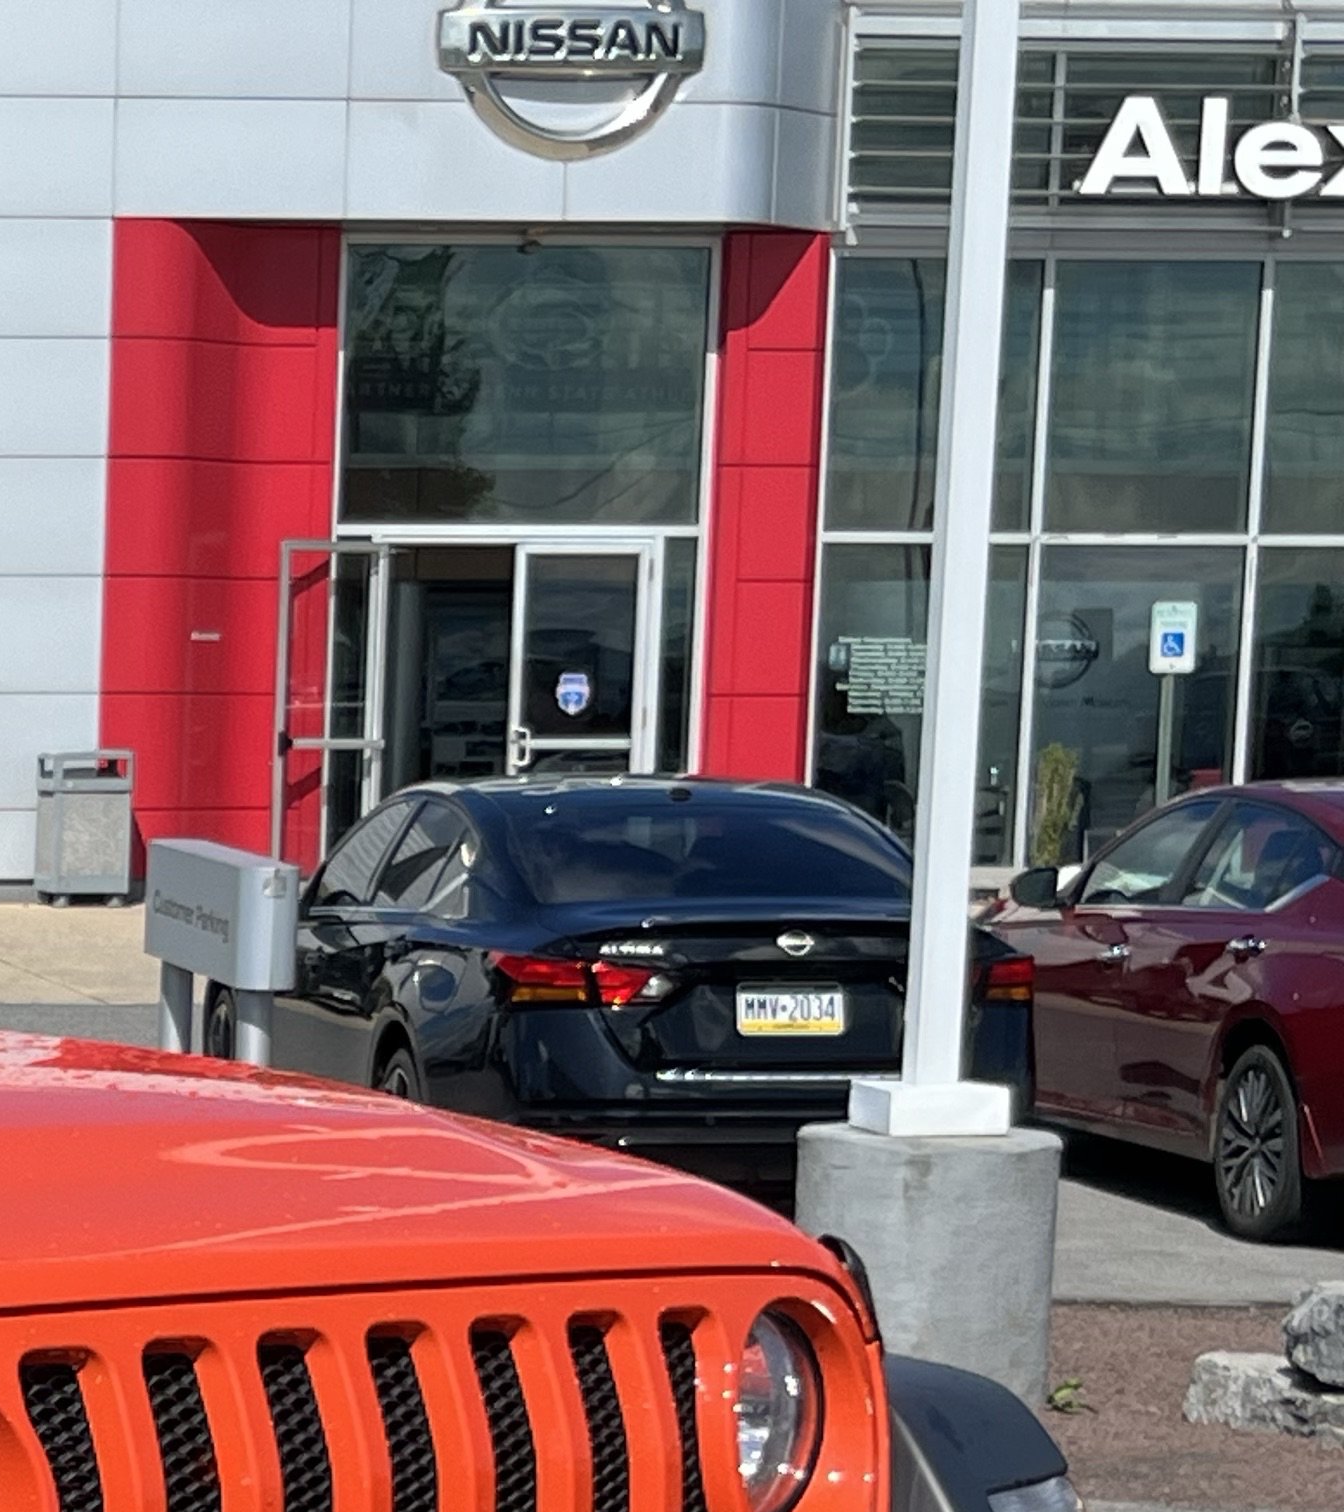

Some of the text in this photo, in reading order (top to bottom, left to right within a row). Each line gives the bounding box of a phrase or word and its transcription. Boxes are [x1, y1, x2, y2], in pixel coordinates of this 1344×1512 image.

[468, 19, 682, 59] NISSAN
[1079, 96, 1343, 198] Ale
[153, 888, 230, 944] Customer Parking
